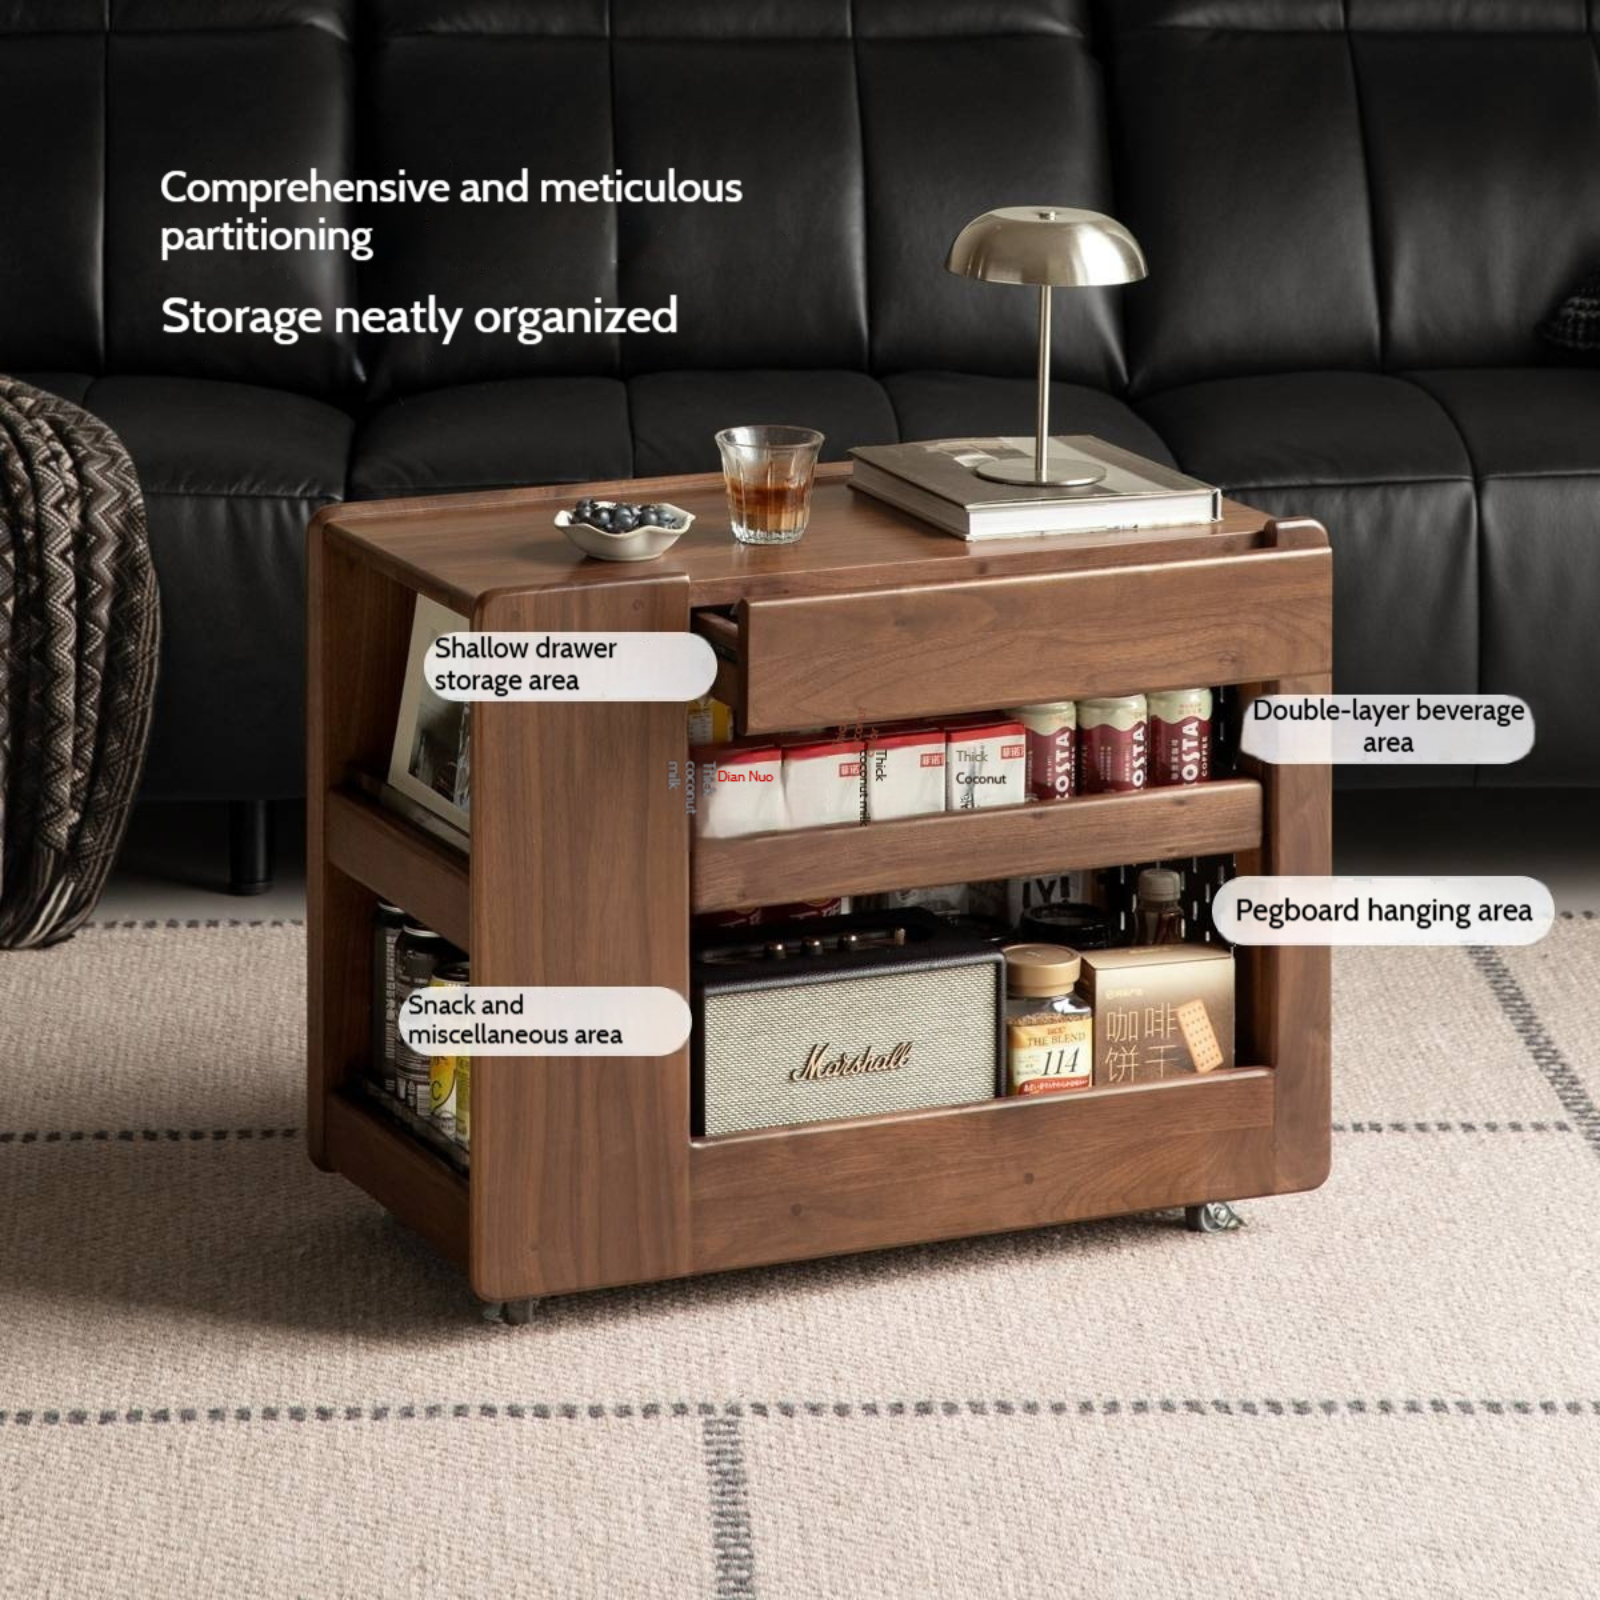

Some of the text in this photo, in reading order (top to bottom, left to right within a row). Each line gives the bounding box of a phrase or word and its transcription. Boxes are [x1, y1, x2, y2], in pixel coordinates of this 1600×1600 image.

[1132, 726, 1145, 790] OSTA
[1182, 721, 1200, 785] OSTA
[1107, 1003, 1178, 1042] 咖啡
[790, 1042, 913, 1082] Marshall
[1041, 1047, 1079, 1076] 114
[1105, 1044, 1178, 1082] 饼干
